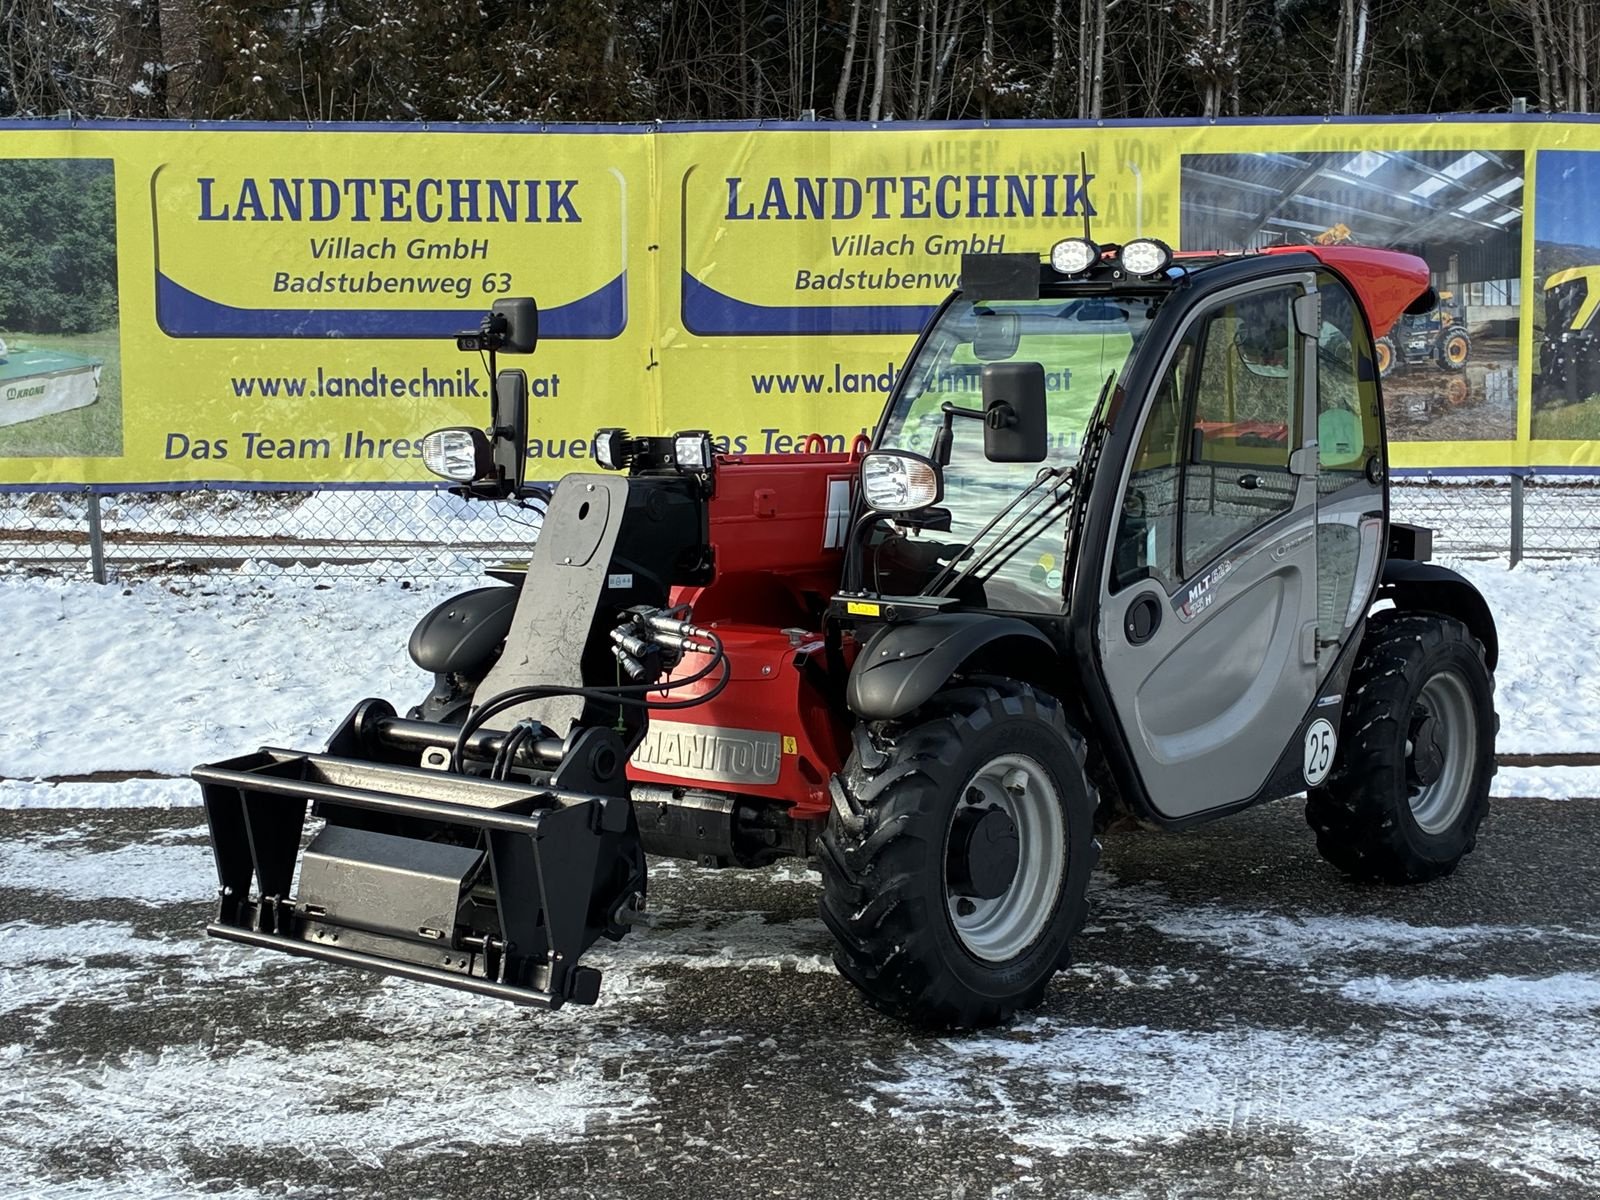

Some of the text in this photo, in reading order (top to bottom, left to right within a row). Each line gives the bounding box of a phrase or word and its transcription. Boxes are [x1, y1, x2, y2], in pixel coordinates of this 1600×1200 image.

[197, 178, 583, 223] LANDTECHNIK
[725, 174, 1099, 221] LANDTECHNIK
[309, 237, 490, 261] Villach GmbH
[831, 233, 1006, 256] Villach GmbH
[273, 270, 513, 299] Badstubenweg 63
[16, 385, 45, 399] KRONE
[164, 430, 425, 460] Das Team Ihres
[1188, 577, 1211, 604] MLT
[632, 729, 779, 777] MANITOU
[1307, 730, 1330, 775] 25
